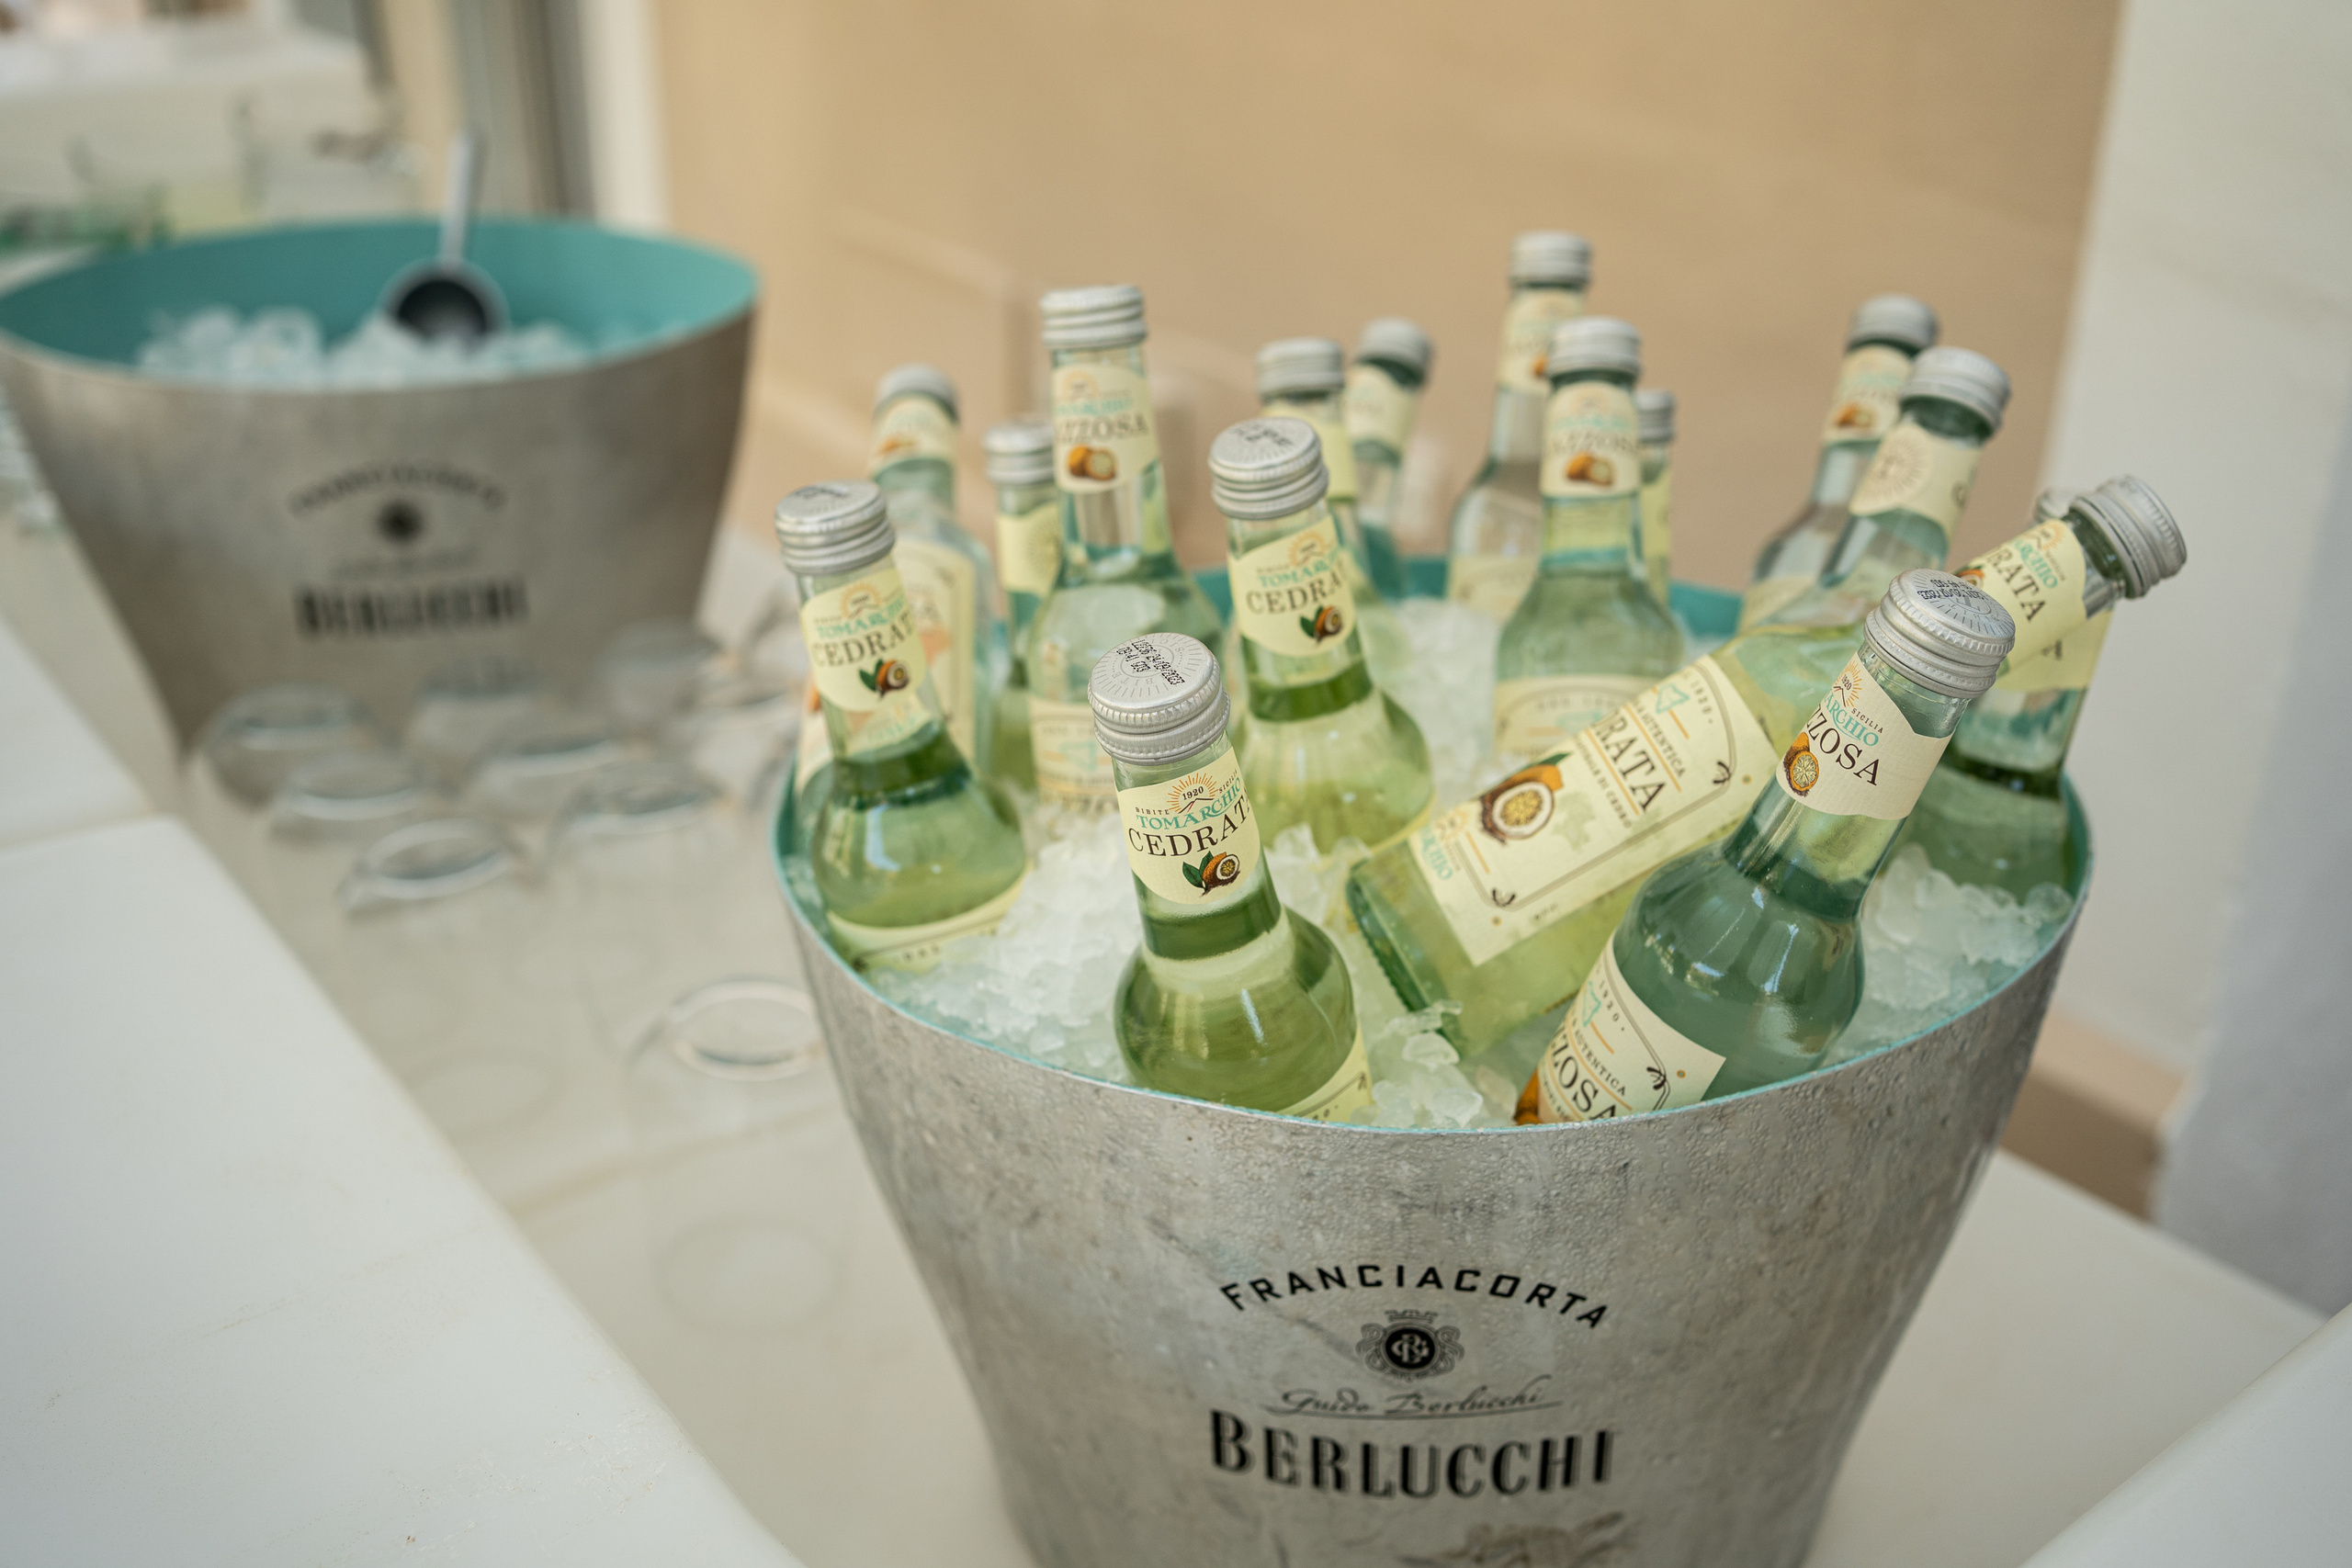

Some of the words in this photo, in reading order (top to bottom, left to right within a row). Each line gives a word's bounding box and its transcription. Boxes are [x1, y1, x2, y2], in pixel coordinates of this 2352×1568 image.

[1841, 673, 1852, 691] 1920
[1851, 707, 1883, 734] SICILIA
[1136, 777, 1240, 830] TOMARCHIO
[1182, 785, 1204, 801] 1920
[1136, 807, 1170, 816] BIBITE
[1220, 1264, 1609, 1329] FRANCIACORTA
[1283, 1387, 1371, 1415] Guido
[1385, 1373, 1552, 1416] Berlucchi
[1210, 1408, 1616, 1499] BERLUCCHI
